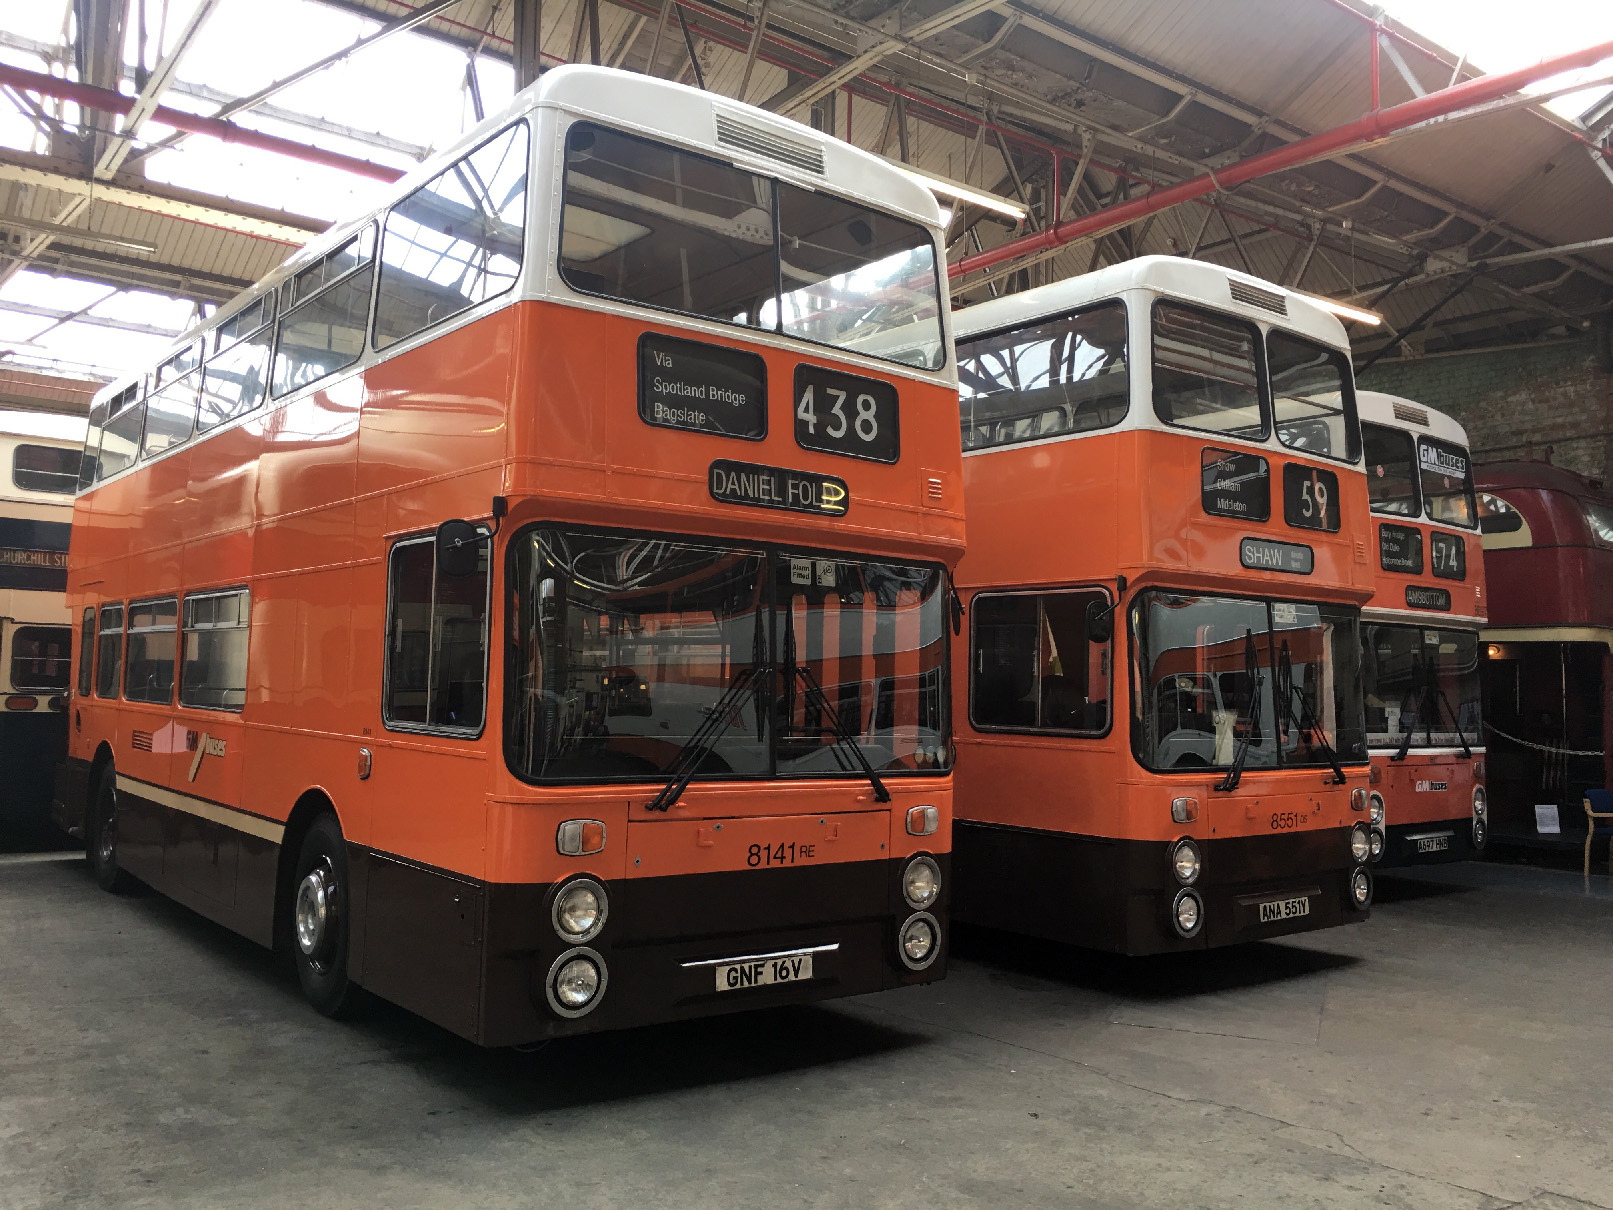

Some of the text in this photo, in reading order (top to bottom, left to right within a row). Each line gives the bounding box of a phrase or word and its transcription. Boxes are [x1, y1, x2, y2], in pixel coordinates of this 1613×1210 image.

[653, 350, 673, 368] Via
[653, 378, 746, 405] Spotland Bridge
[653, 403, 706, 425] Bagslate
[797, 385, 878, 441] 438
[1217, 459, 1236, 471] Shaw
[713, 468, 840, 506] DANIEL FOLD
[1217, 479, 1241, 491] Oldham
[1217, 498, 1247, 511] Middleton
[1301, 481, 1328, 518] 59
[1245, 546, 1282, 566] SHAW
[793, 572, 810, 580] Fitted
[1271, 812, 1299, 829] 8551
[747, 842, 815, 867] 8141 RE
[1262, 897, 1309, 920] ANA 551Y
[727, 959, 803, 987] GNF 16V
